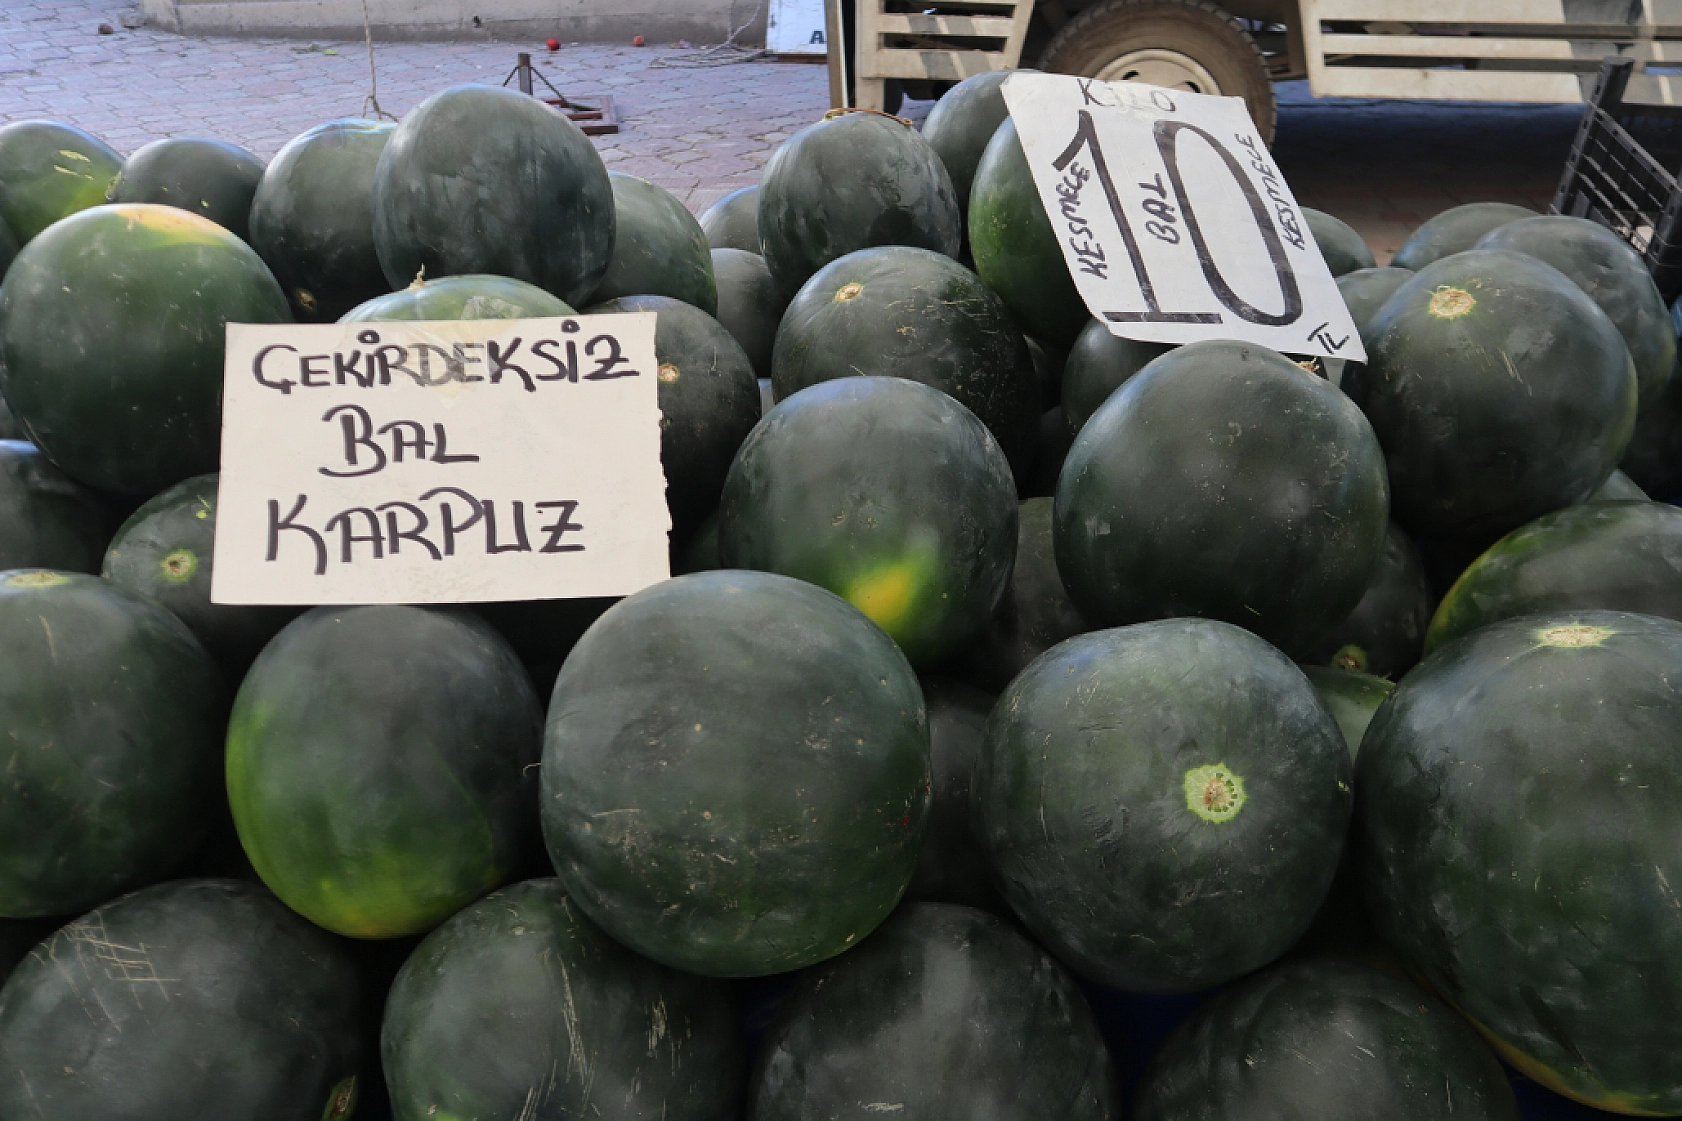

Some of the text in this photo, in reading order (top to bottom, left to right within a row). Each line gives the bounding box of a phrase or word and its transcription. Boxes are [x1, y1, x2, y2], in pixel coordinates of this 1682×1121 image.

[1052, 109, 1303, 326] 10
[1056, 162, 1108, 279] KESMECE
[1139, 173, 1180, 245] BAL
[252, 320, 640, 394] ÇEKİRDEKSİZ
[1308, 322, 1350, 355] TL
[318, 404, 480, 478] BAL
[264, 487, 586, 576] KARPUZ
